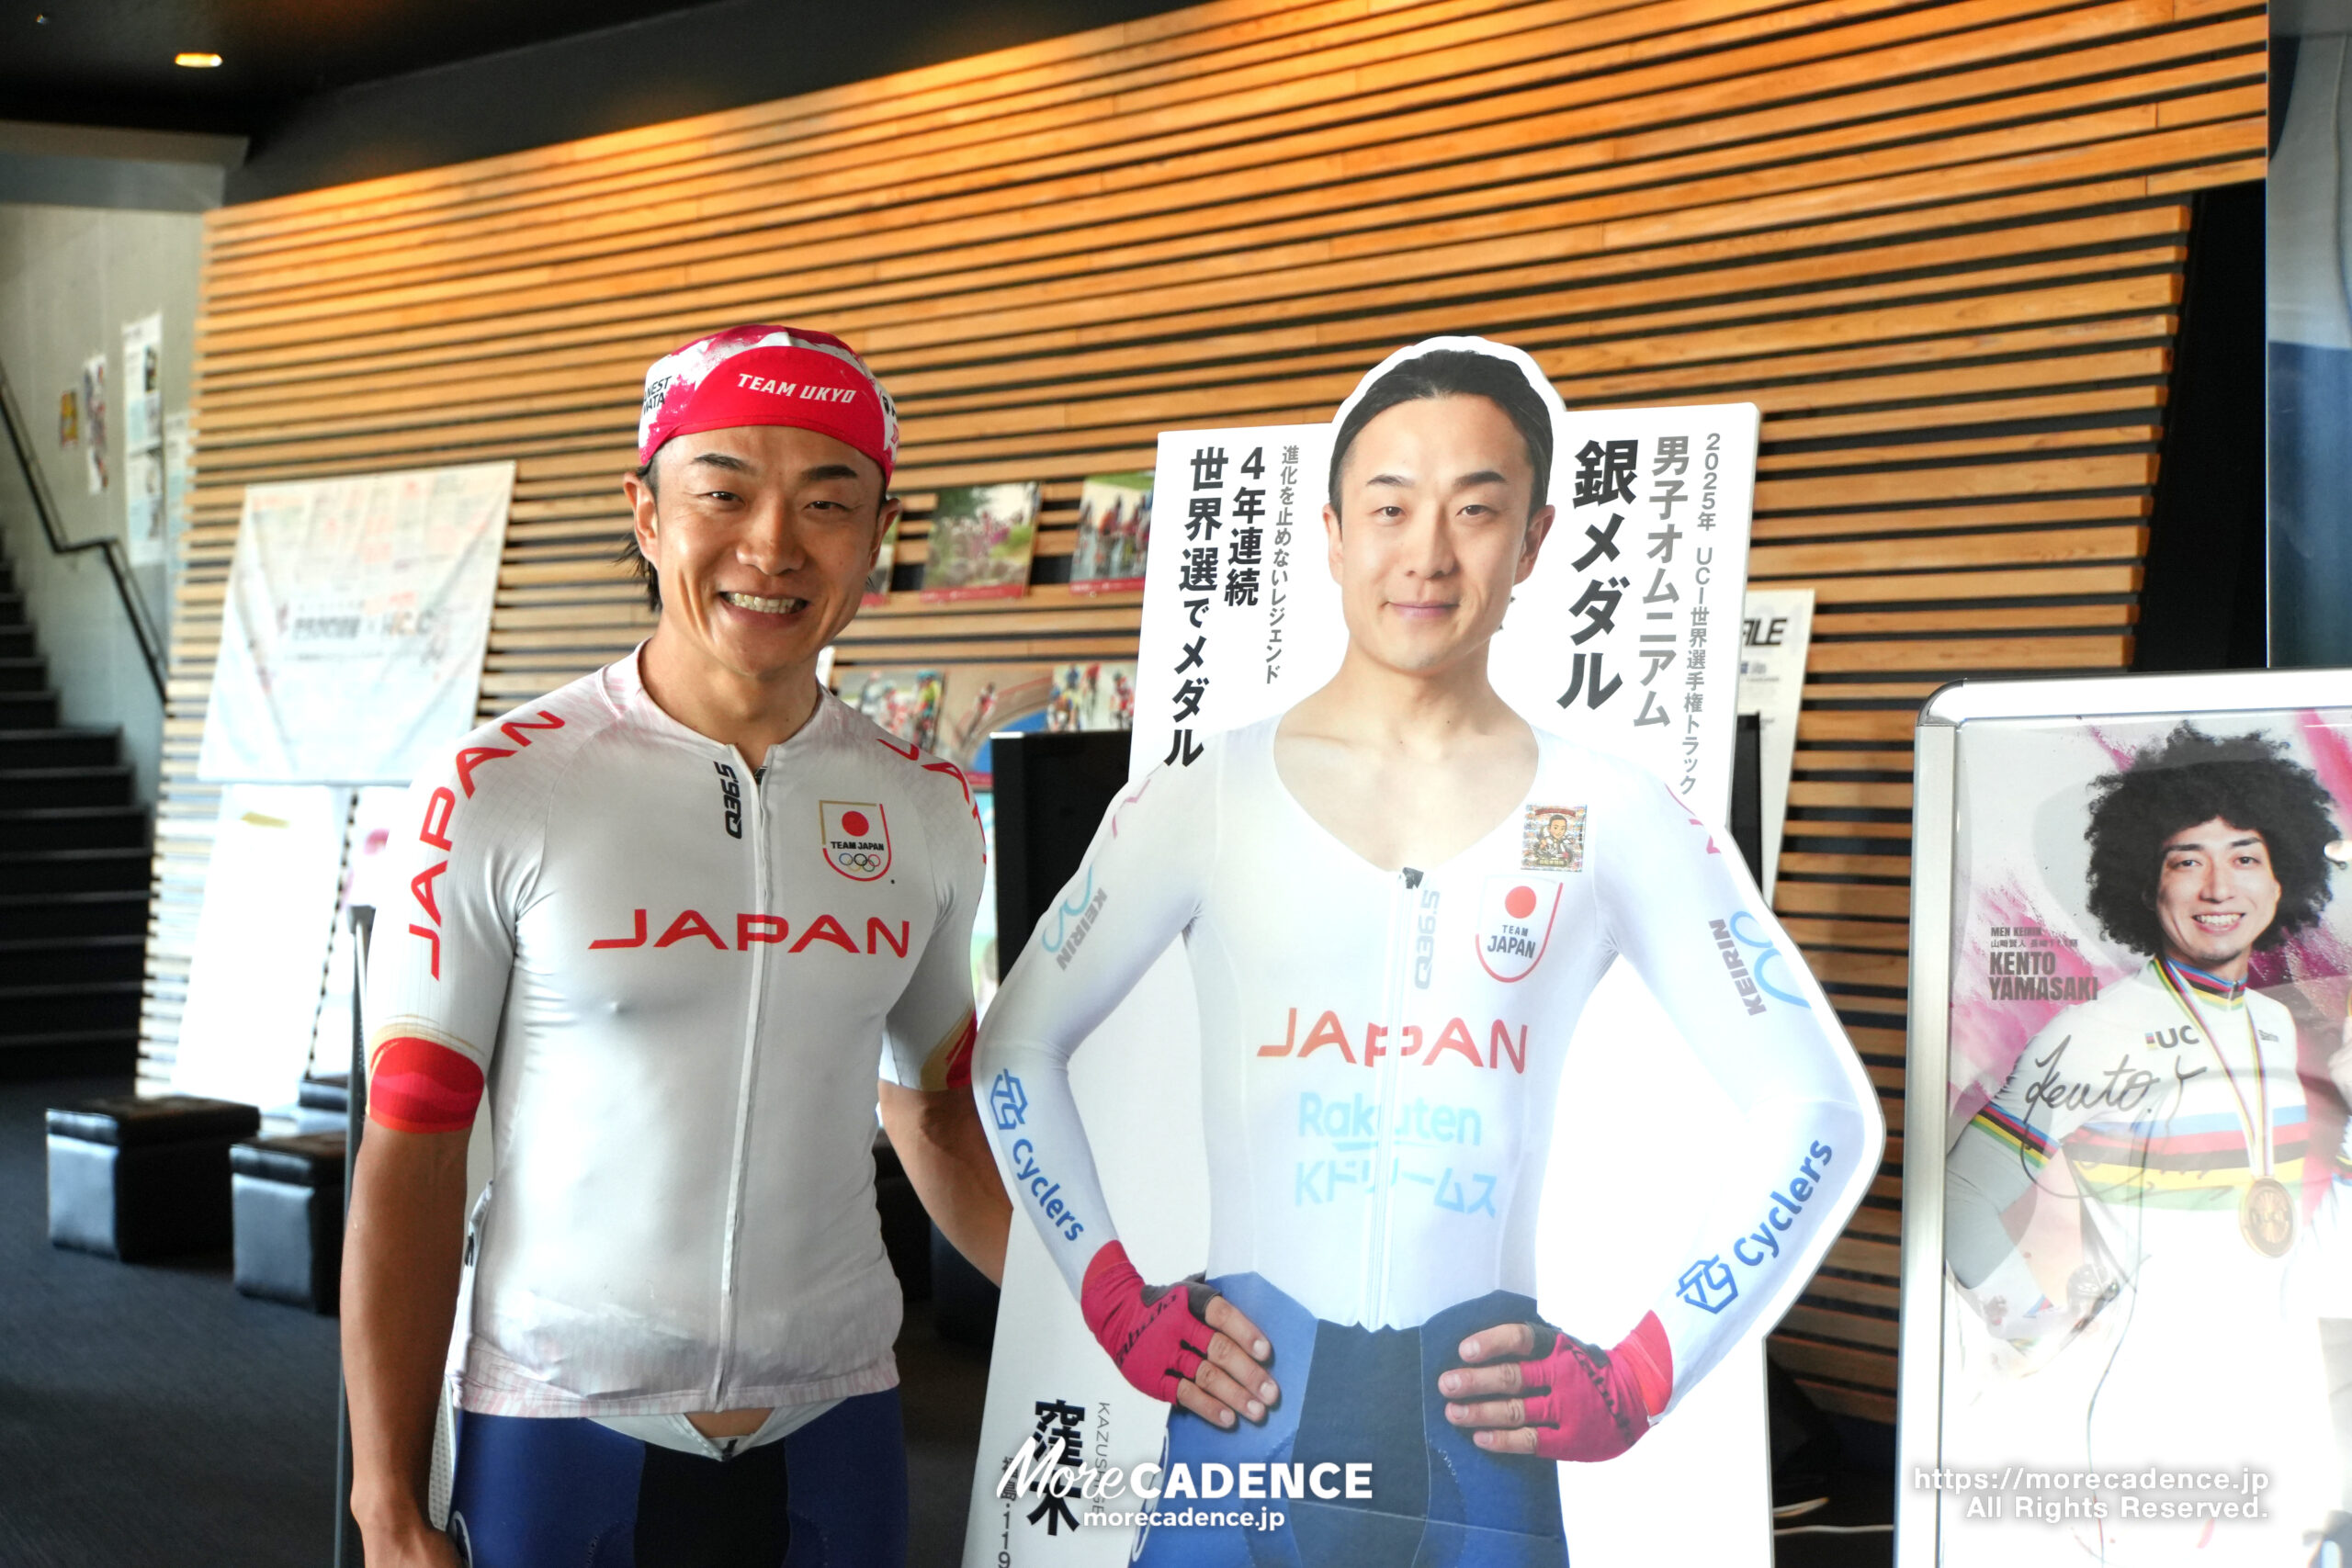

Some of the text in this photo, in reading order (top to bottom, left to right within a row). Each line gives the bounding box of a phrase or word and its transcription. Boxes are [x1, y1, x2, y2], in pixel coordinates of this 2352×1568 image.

[644, 376, 672, 401] NEST
[738, 373, 856, 403] TEAM UKYO
[1697, 433, 1721, 531] 2025年
[1224, 447, 1266, 606] 4年連続
[1265, 446, 1299, 684] 進化を止めないレジェンド
[1556, 439, 1638, 710] 銀メダル
[1634, 435, 1690, 727] 男子オムニアム
[1164, 446, 1229, 767] 世界選でメダル
[409, 710, 565, 981] JAPAN
[858, 842, 884, 851] JAPAN
[588, 908, 910, 958] JAPAN
[1057, 887, 1108, 971] KEIRIN
[1487, 935, 1536, 958] JAPAN
[1502, 925, 1529, 937] TEAM
[1989, 952, 2056, 975] KENTO
[1991, 927, 2010, 937] MEN
[1709, 919, 1767, 1016] KEIRIN
[1988, 977, 2098, 1000] YAMASAKI
[1257, 1007, 1528, 1074] JAPAN
[1298, 1091, 1482, 1146] Rakuten
[1012, 1138, 1084, 1241] Cyclers
[1734, 1140, 1833, 1267] Cyclers
